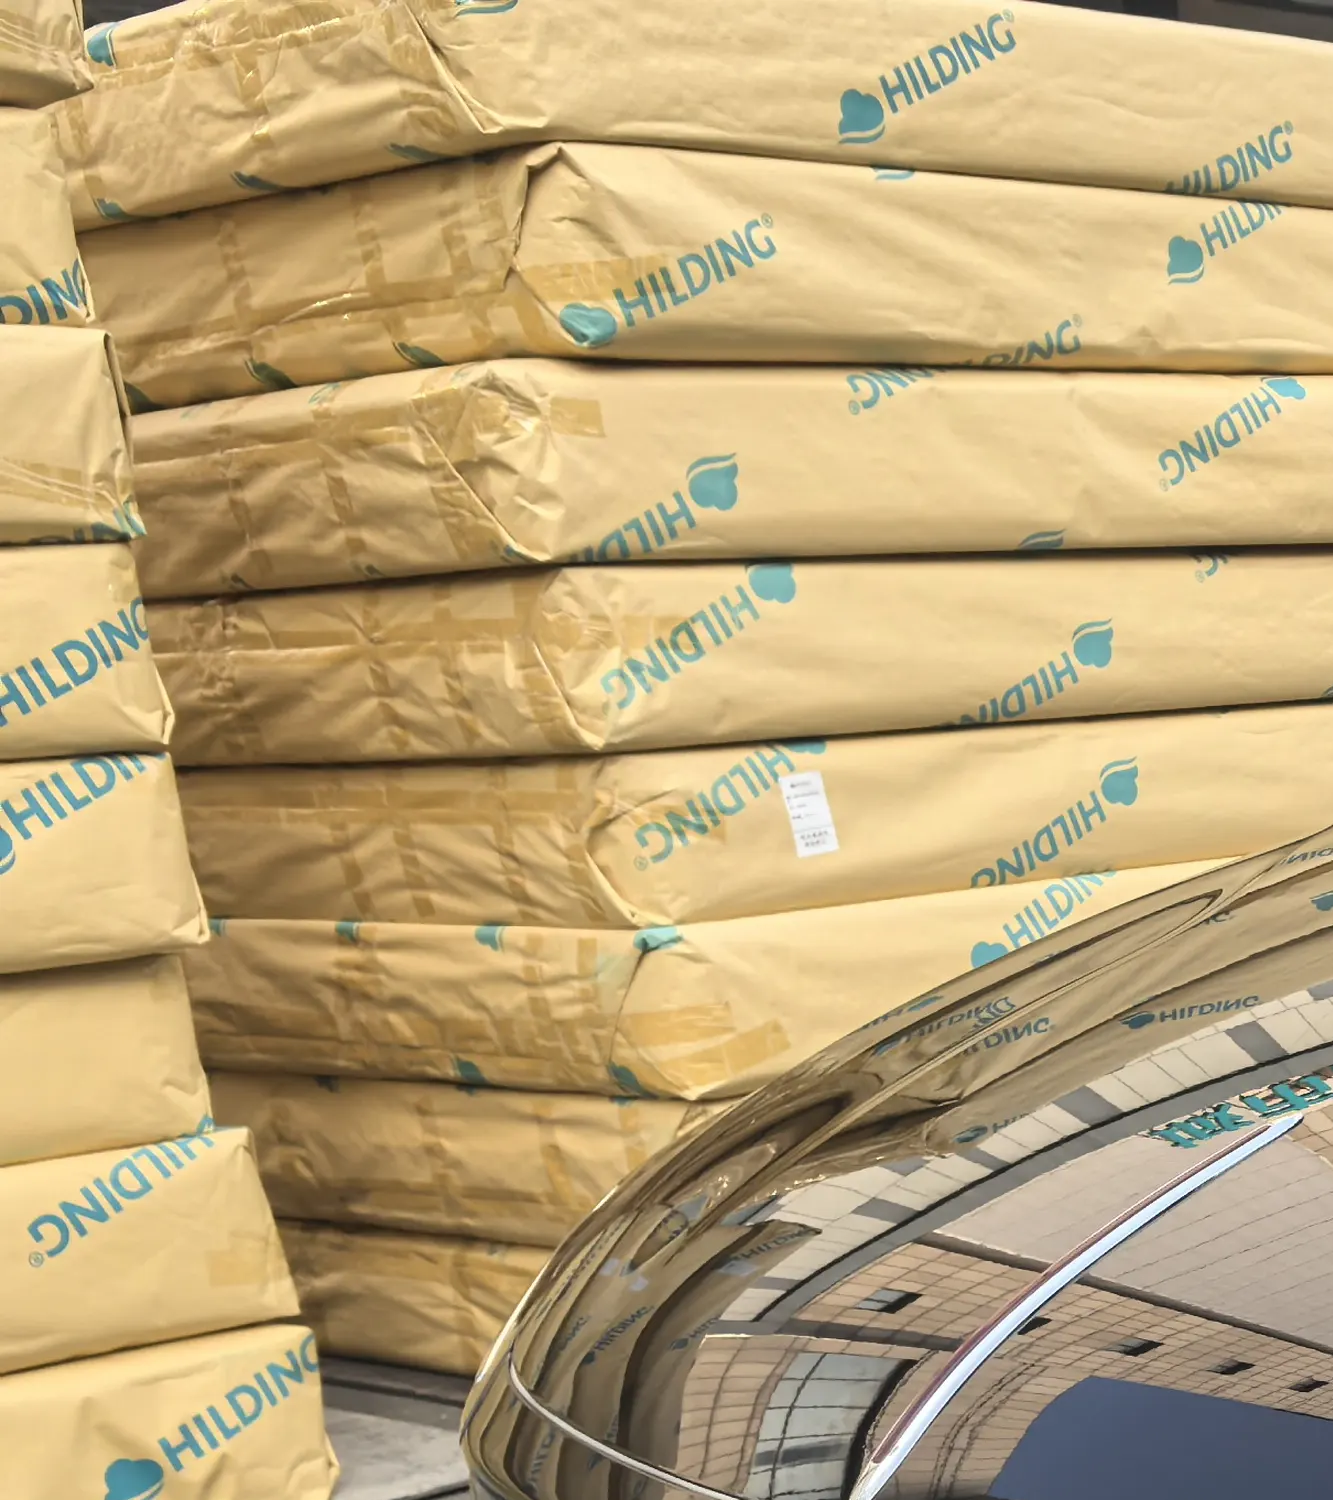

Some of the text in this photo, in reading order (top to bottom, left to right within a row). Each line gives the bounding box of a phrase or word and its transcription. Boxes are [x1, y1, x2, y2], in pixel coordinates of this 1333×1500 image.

[879, 18, 1016, 113] HILDING
[614, 225, 777, 328] HILDING
[1161, 388, 1281, 487] HILDING
